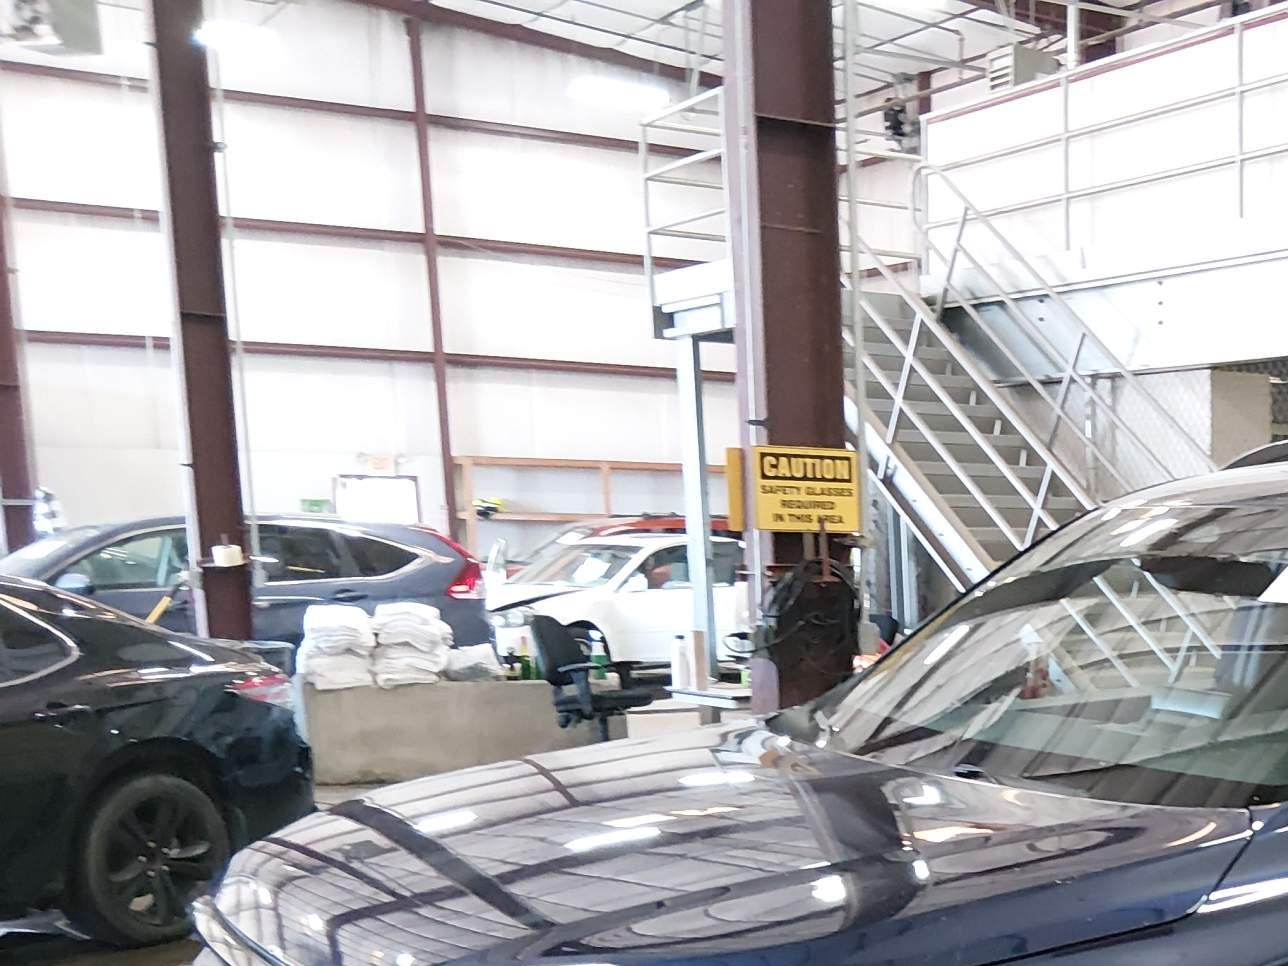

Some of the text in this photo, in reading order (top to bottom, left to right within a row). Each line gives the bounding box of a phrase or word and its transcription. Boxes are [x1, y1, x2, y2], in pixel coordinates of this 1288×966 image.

[763, 455, 850, 480] CAUTION
[761, 485, 853, 496] SAFETY GLASSES
[781, 500, 835, 510] REQUIRED
[773, 513, 844, 524] IN THIS AREA
